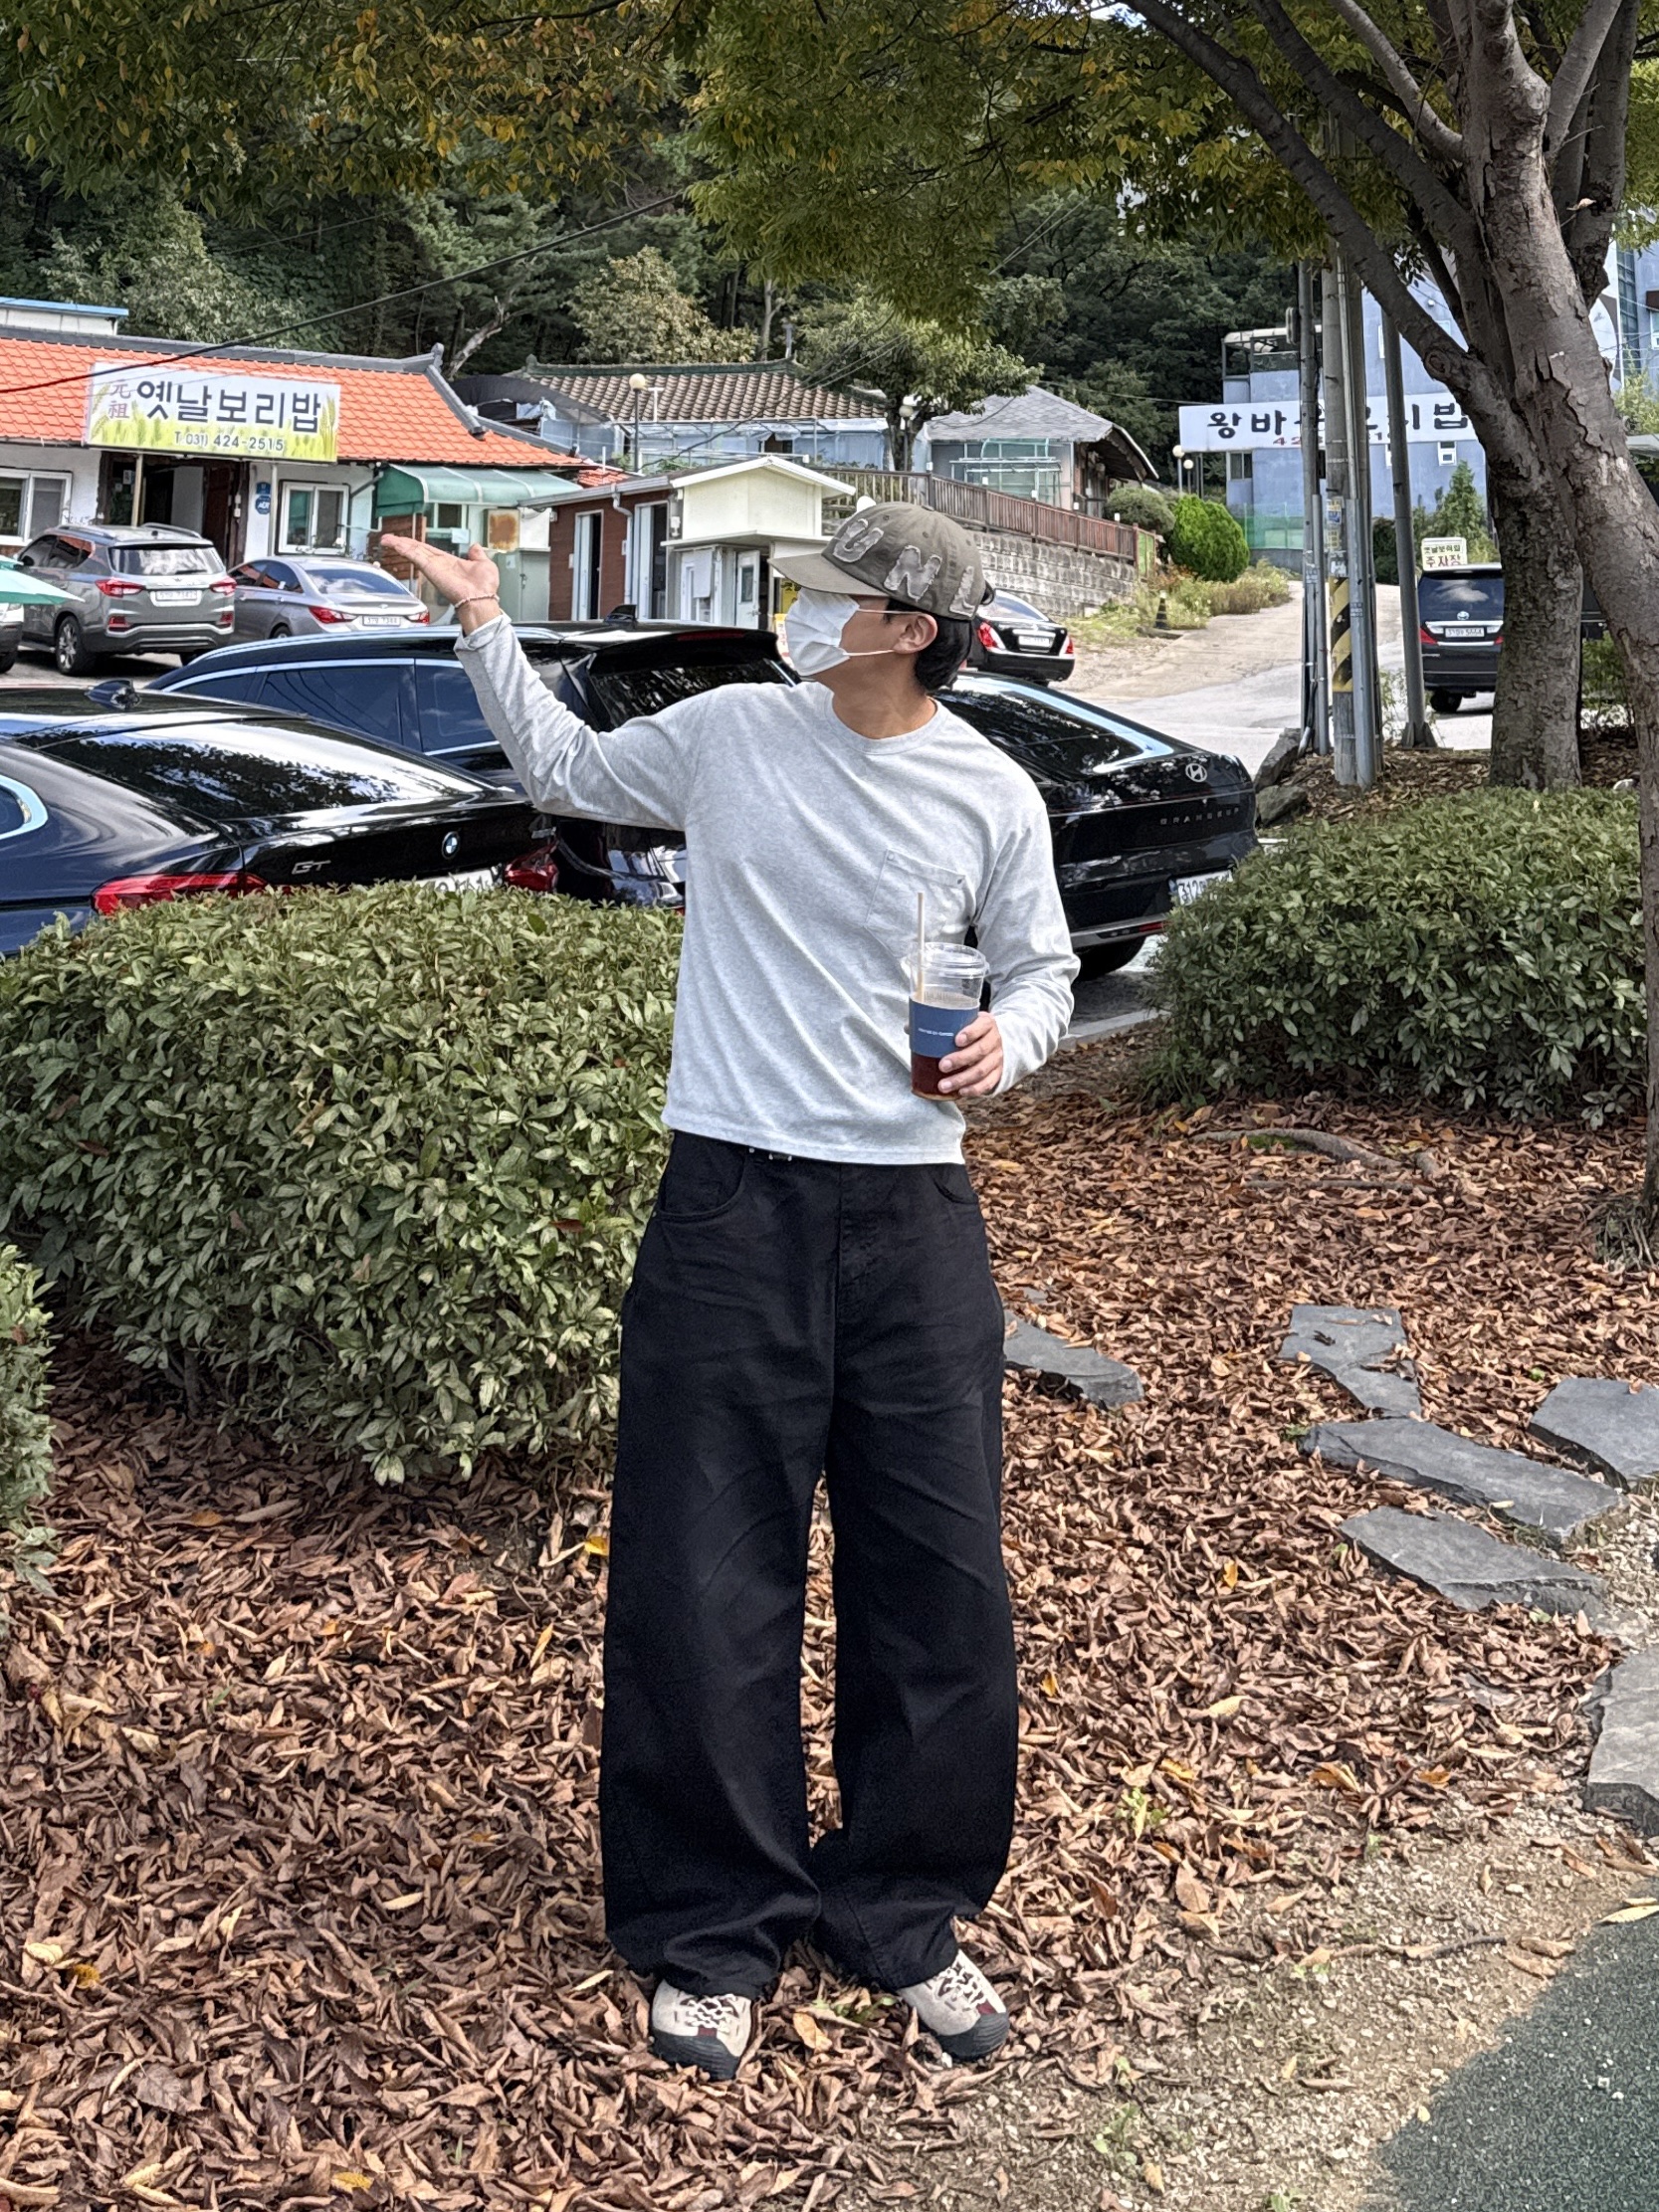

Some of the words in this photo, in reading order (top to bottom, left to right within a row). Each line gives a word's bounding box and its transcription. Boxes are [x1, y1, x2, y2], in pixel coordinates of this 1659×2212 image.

[137, 380, 320, 434] 옛날보리밥
[213, 434, 284, 452] 424-2515
[291, 860, 331, 875] GT
